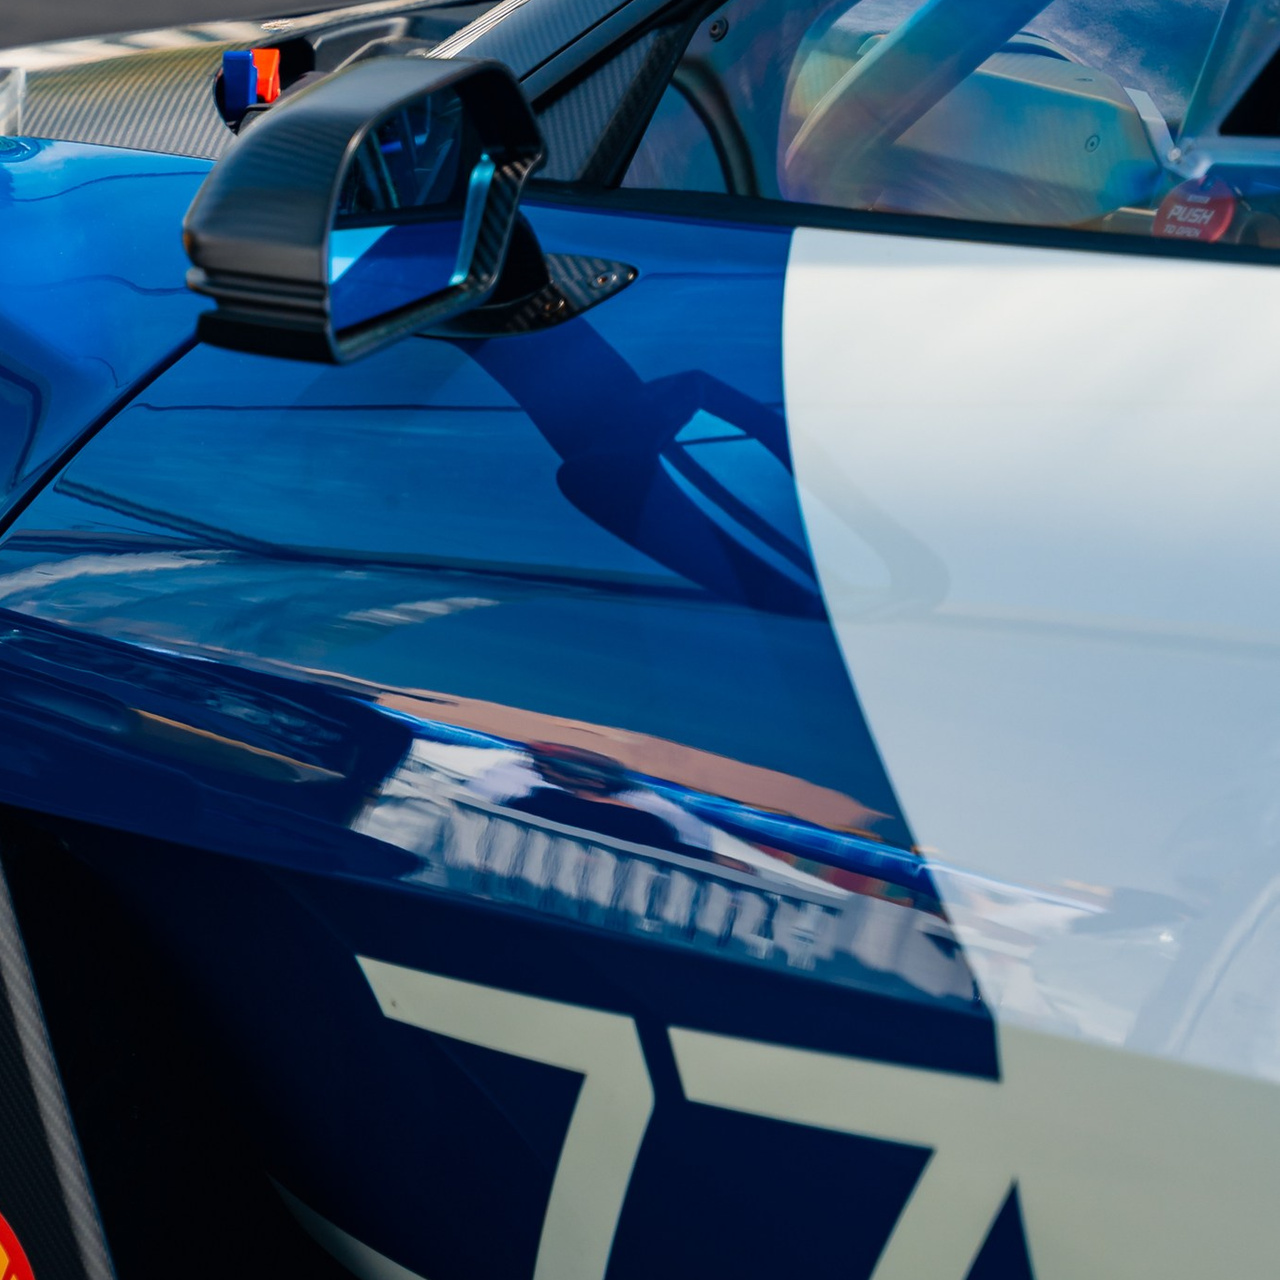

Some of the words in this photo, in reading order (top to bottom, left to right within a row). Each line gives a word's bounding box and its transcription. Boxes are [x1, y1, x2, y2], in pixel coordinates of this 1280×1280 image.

[1166, 204, 1216, 225] PUSH
[1163, 224, 1176, 234] TO
[1176, 225, 1202, 238] OPEN
